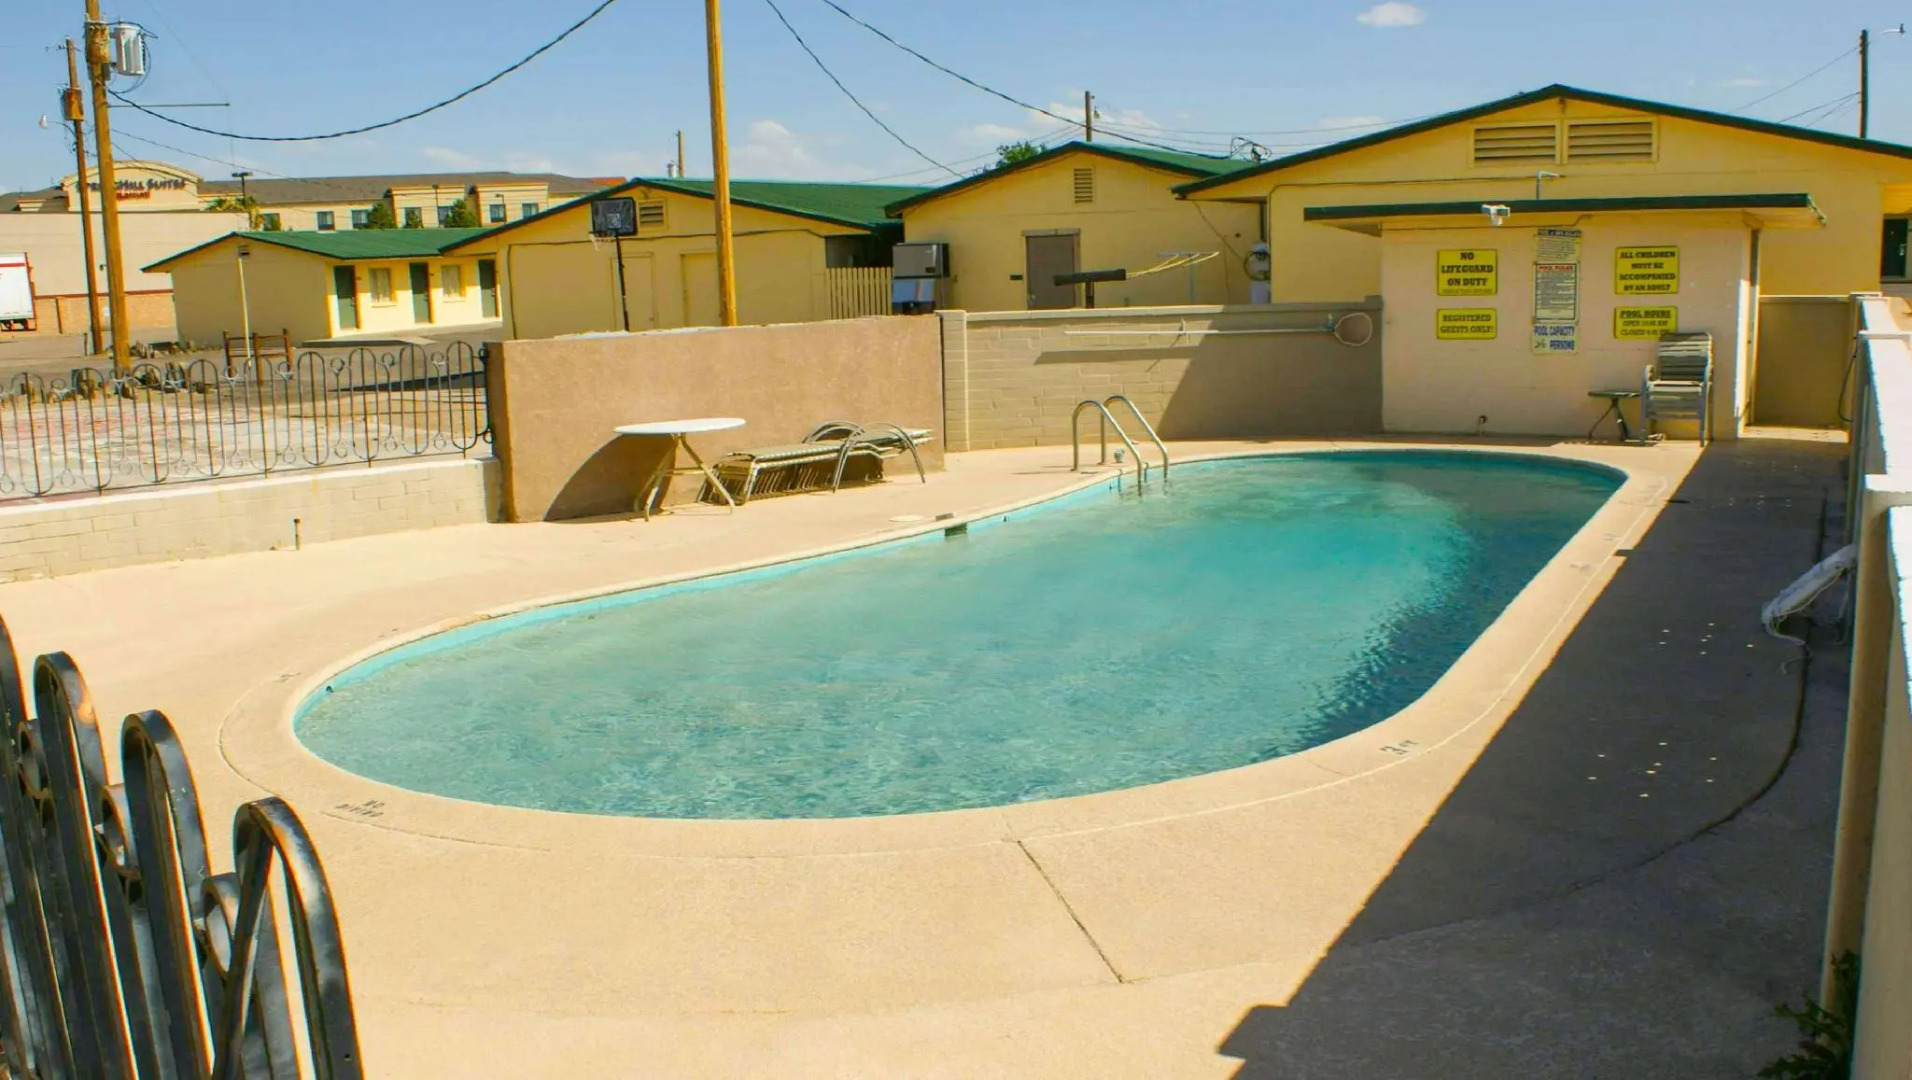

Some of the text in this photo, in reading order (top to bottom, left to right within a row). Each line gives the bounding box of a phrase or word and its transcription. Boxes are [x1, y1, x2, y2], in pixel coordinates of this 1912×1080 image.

[1460, 252, 1475, 260] NO
[1620, 251, 1634, 259] ALL
[1441, 265, 1493, 273] LIFEGUARD
[1447, 278, 1488, 286] ON DUTY
[1620, 309, 1671, 318] POOL HOURS
[1442, 314, 1492, 322] REGISTERED
[1440, 325, 1469, 333] GUESTS
[1534, 325, 1576, 336] POOL CAPACITY
[1550, 340, 1576, 350] PERSONS
